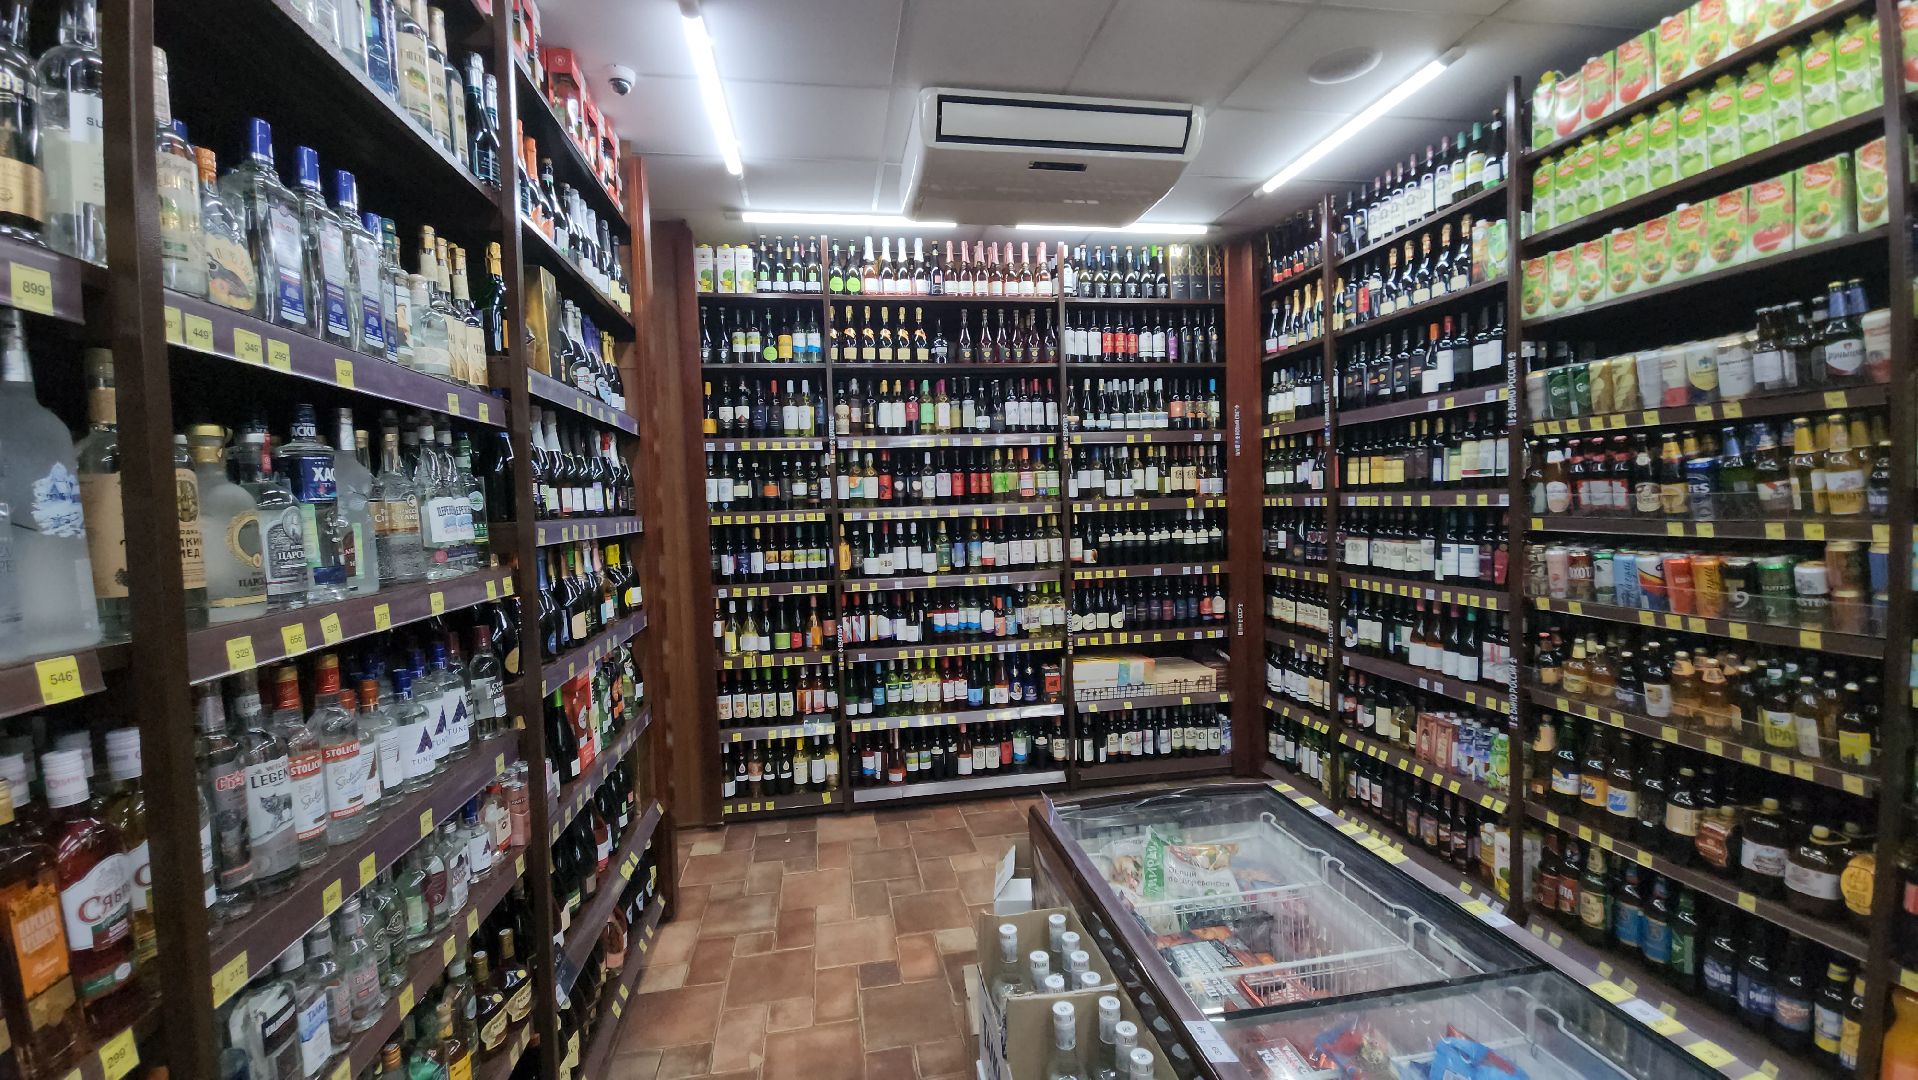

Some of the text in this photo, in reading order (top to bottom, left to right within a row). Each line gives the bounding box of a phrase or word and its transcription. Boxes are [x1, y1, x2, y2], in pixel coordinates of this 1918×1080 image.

[22, 280, 46, 297] 899
[192, 327, 209, 340] 449
[235, 648, 250, 659] 329
[50, 671, 73, 686] 546
